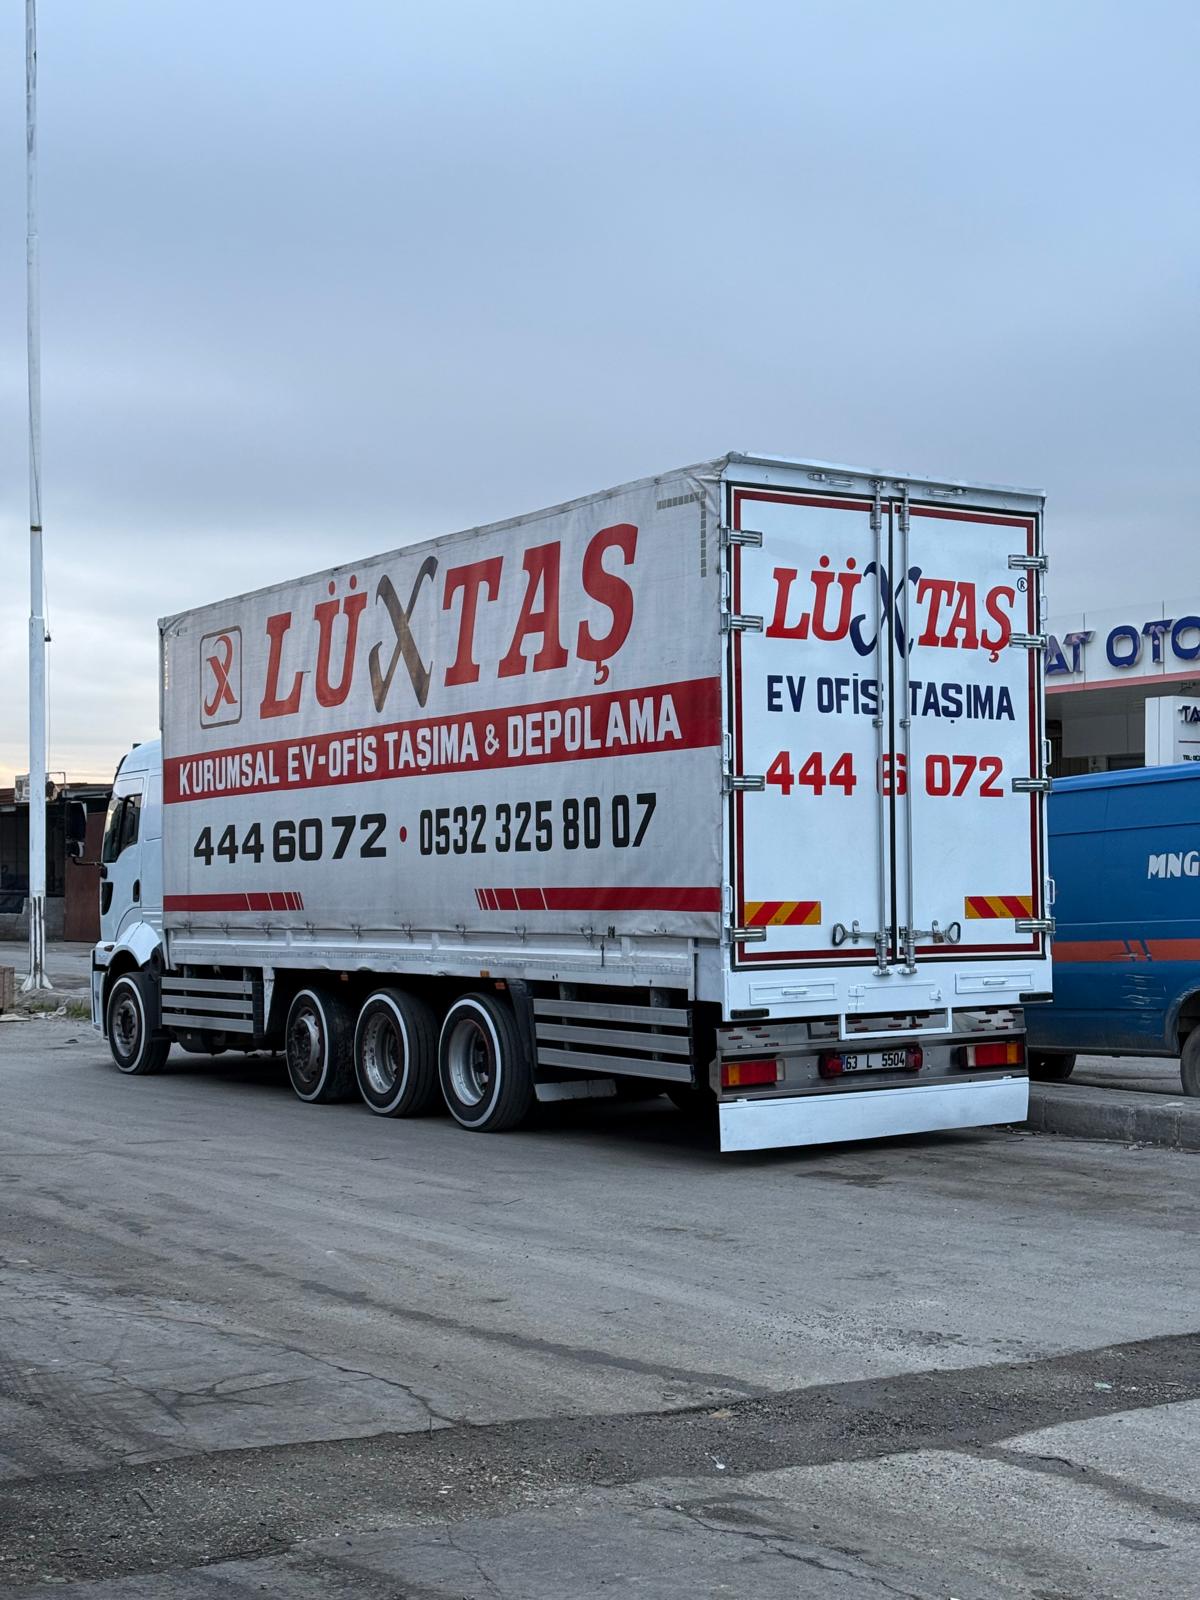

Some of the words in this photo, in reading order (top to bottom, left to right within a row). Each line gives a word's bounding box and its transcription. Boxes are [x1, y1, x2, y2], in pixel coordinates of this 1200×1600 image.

[1106, 616, 1200, 669] OTO
[767, 674, 806, 712] EV
[816, 673, 884, 716] OFİS
[908, 680, 1016, 724] TAŞIMA
[179, 749, 280, 796] KURUMSAL
[287, 732, 377, 782] EV-OFİS
[384, 721, 479, 772] TAŞIMA
[484, 723, 500, 756] &
[507, 694, 682, 758] DEPOLAMA
[766, 750, 857, 796] 444
[925, 754, 1004, 797] 072
[419, 804, 486, 856] 0532
[495, 800, 553, 853] 325
[1147, 851, 1200, 880] MNG
[845, 1055, 858, 1070] 63
[866, 1053, 873, 1069] L
[881, 1051, 905, 1067] 5504
